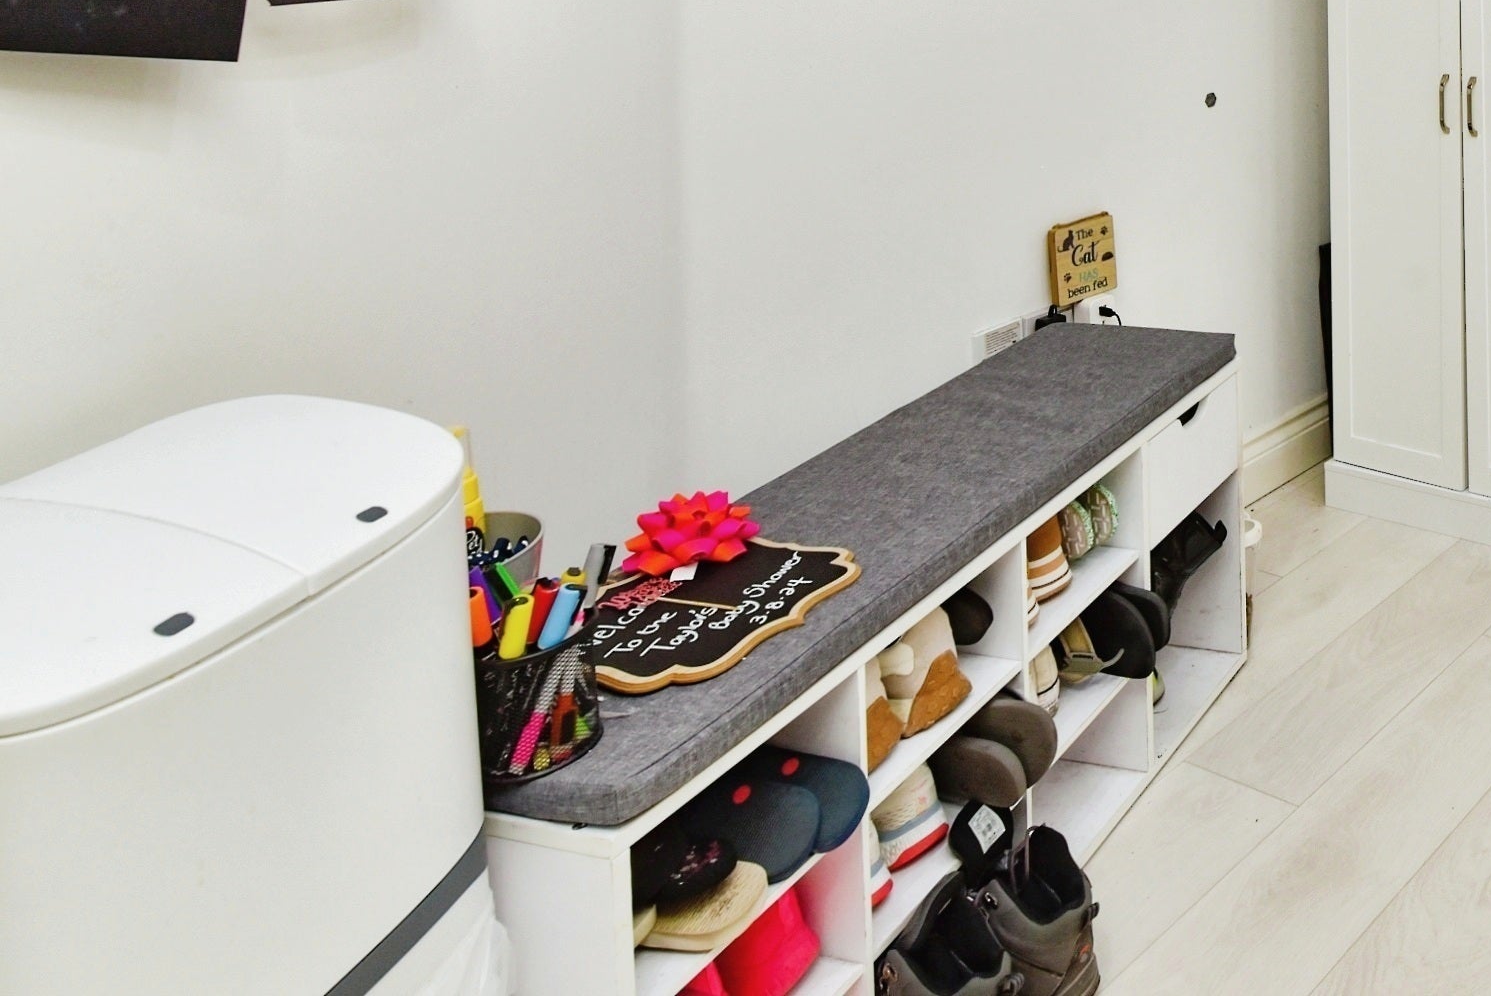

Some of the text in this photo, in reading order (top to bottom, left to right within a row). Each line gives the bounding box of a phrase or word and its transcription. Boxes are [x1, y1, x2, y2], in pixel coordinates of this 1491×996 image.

[1075, 228, 1094, 241] The
[1071, 240, 1100, 267] Cat
[1067, 276, 1108, 299] been fed
[708, 550, 803, 631] Baby Shower
[603, 639, 643, 658] To
